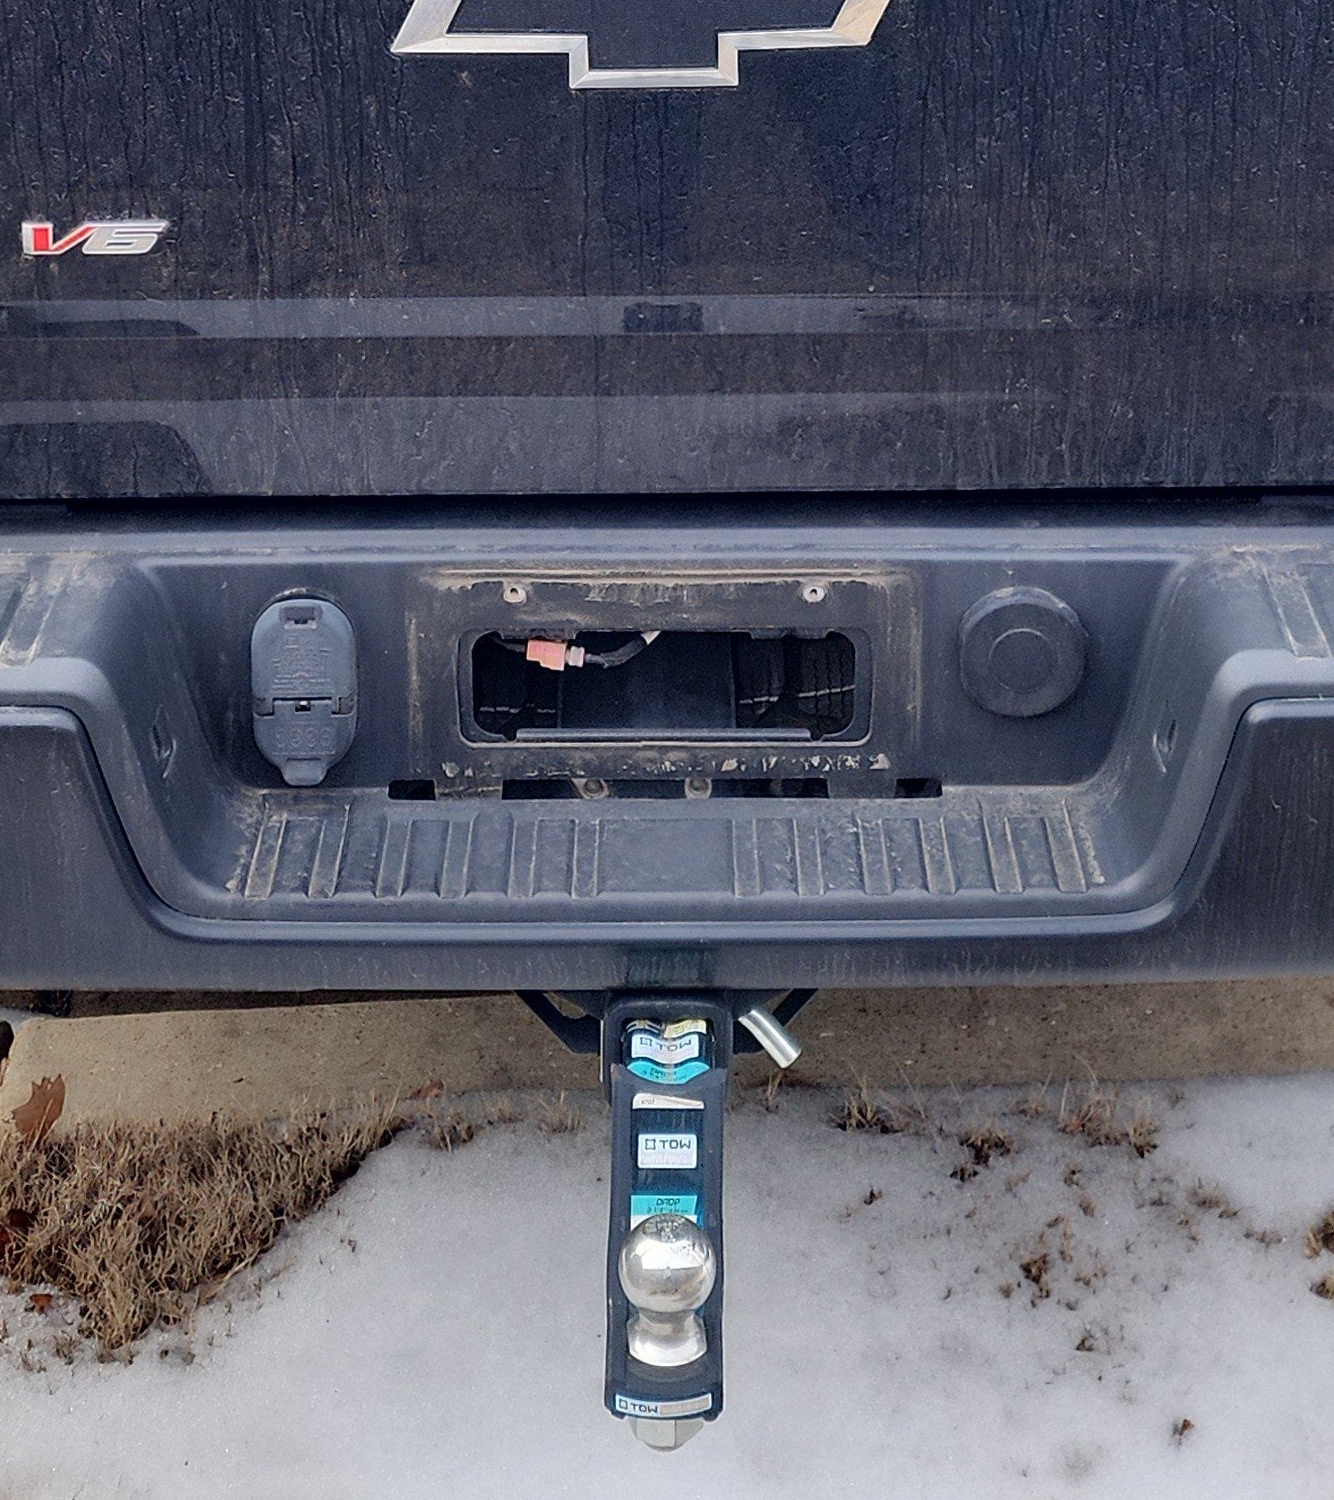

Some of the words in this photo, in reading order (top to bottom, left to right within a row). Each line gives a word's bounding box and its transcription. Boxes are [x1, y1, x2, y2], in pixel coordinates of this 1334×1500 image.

[21, 218, 168, 257] V6
[655, 1038, 692, 1052] TOW
[659, 1138, 692, 1150] TOW
[630, 1402, 659, 1414] TOW
